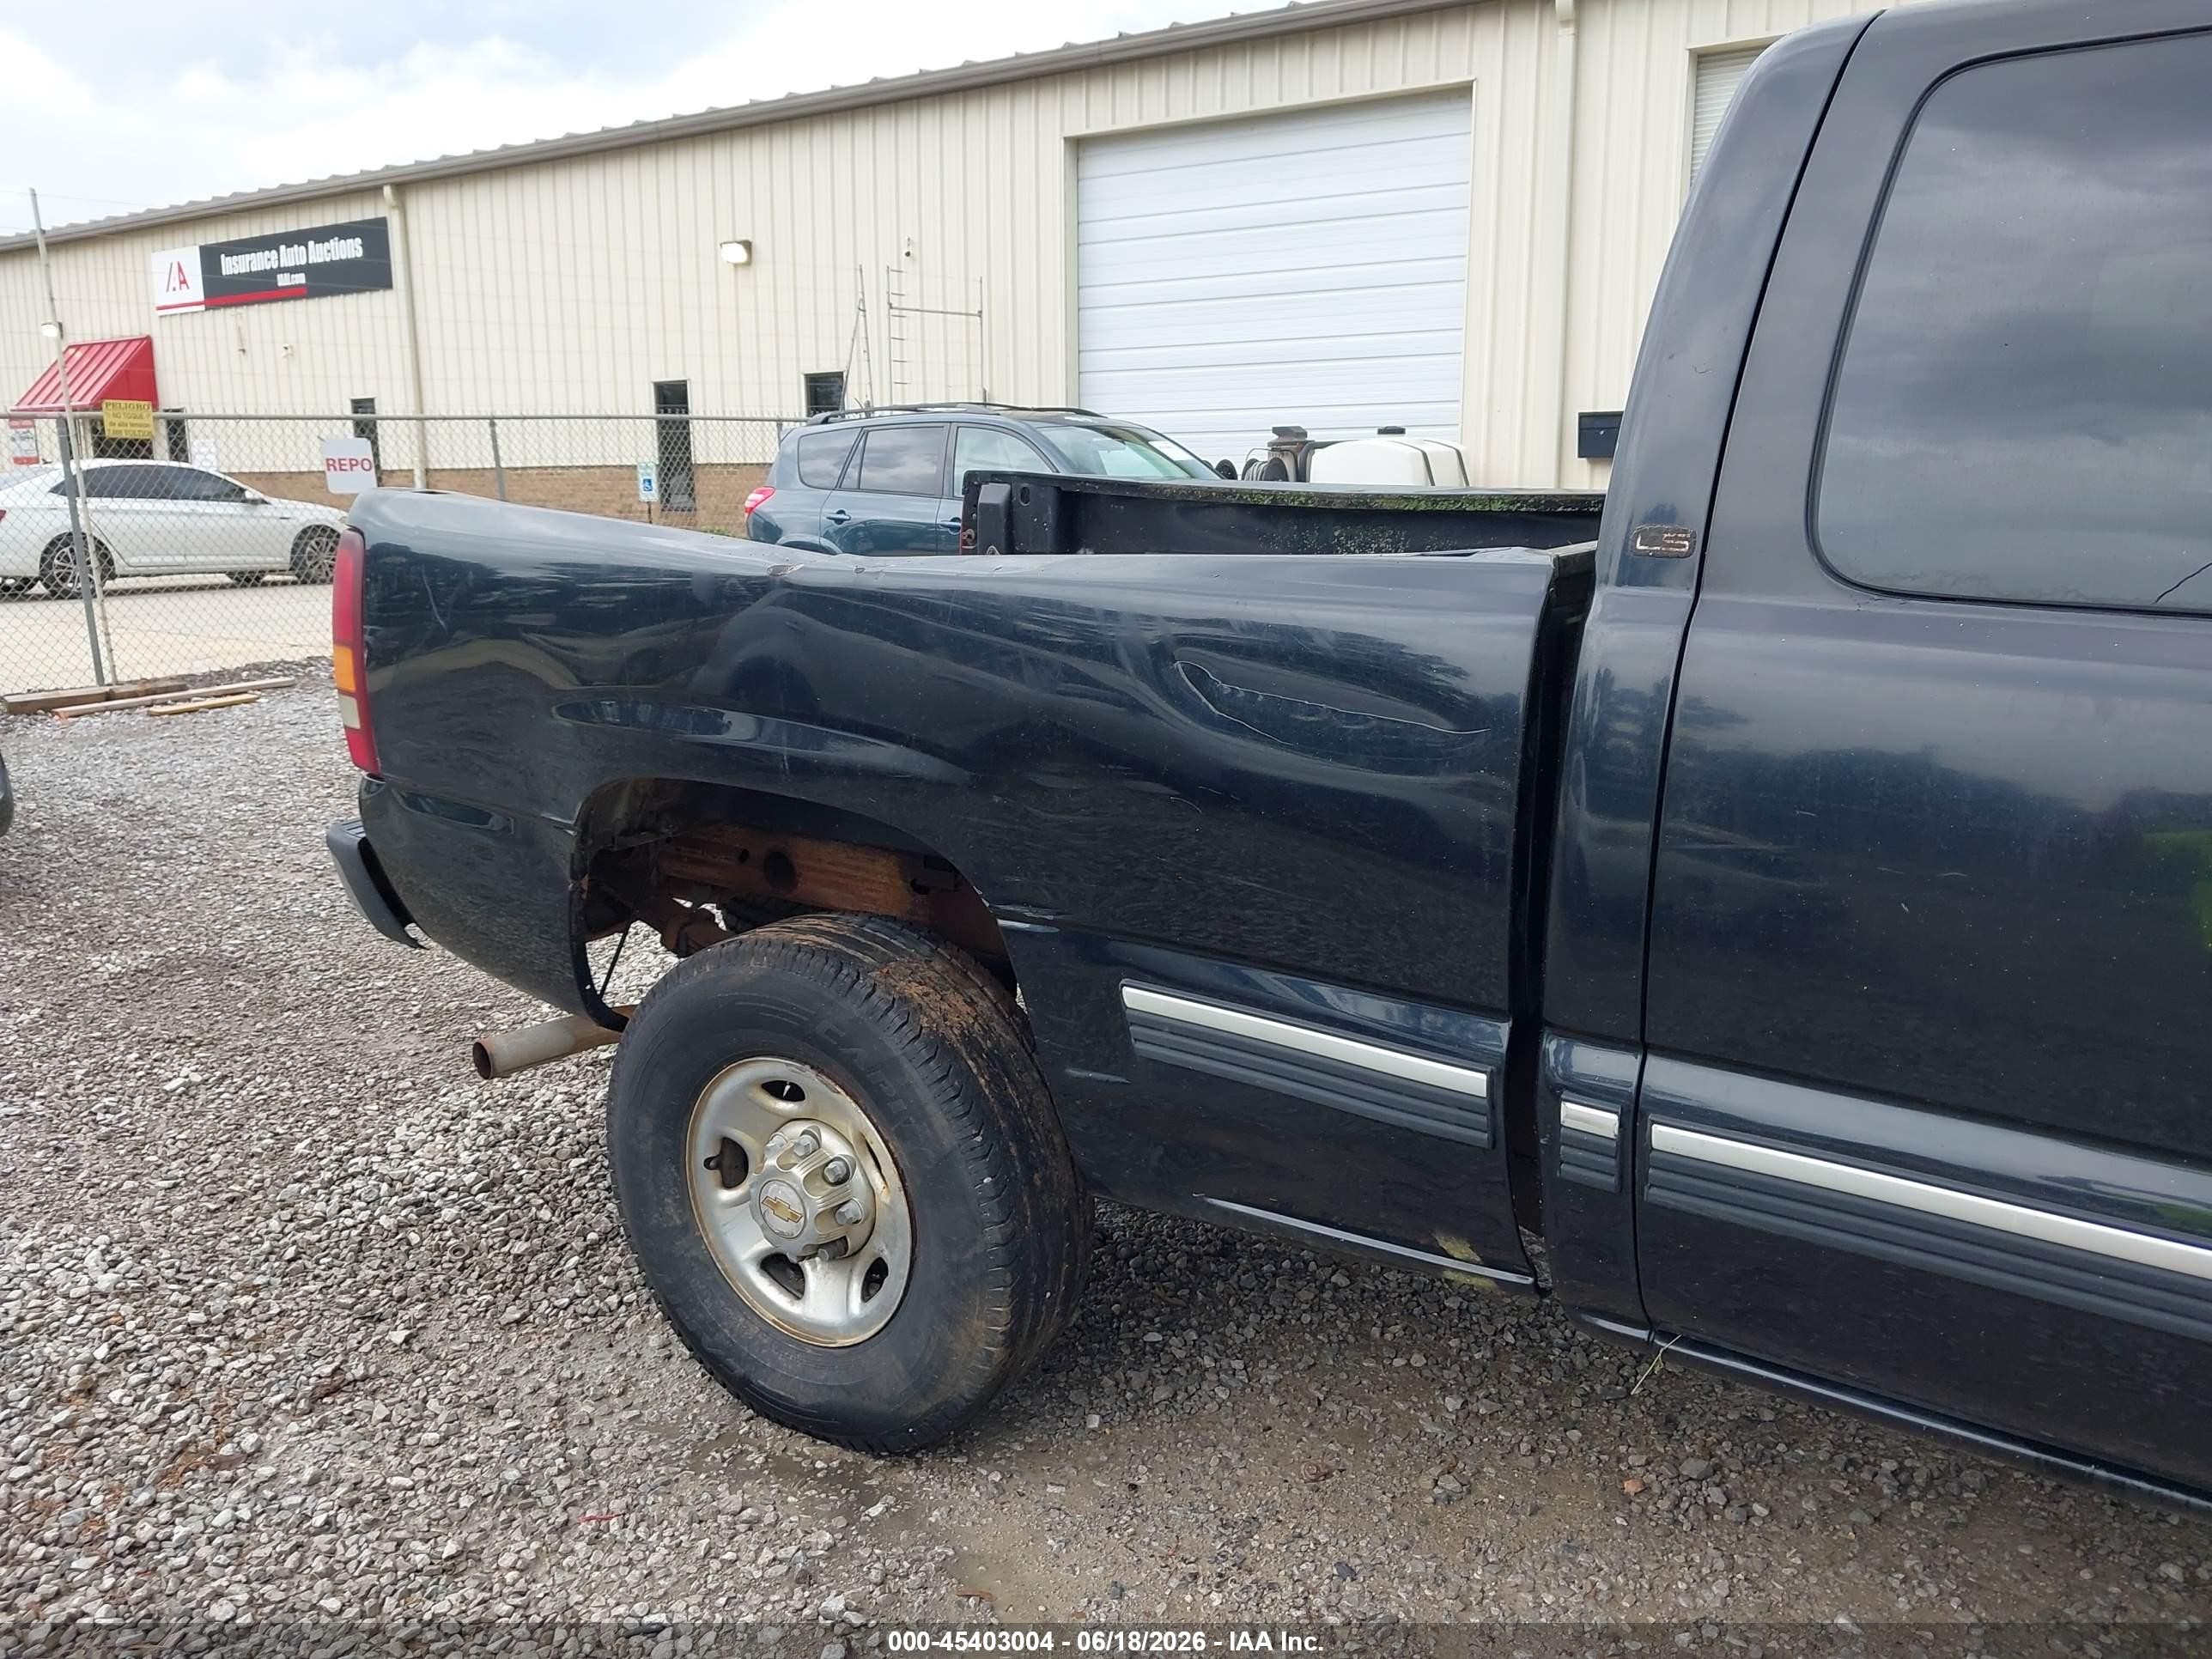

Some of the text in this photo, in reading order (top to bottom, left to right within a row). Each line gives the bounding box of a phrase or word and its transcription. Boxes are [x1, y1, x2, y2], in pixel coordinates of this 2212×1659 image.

[220, 236, 363, 276] Insurance Auto Auctions
[105, 402, 150, 411] PELIGRO
[325, 458, 373, 471] REPO
[1635, 532, 1690, 552] LS
